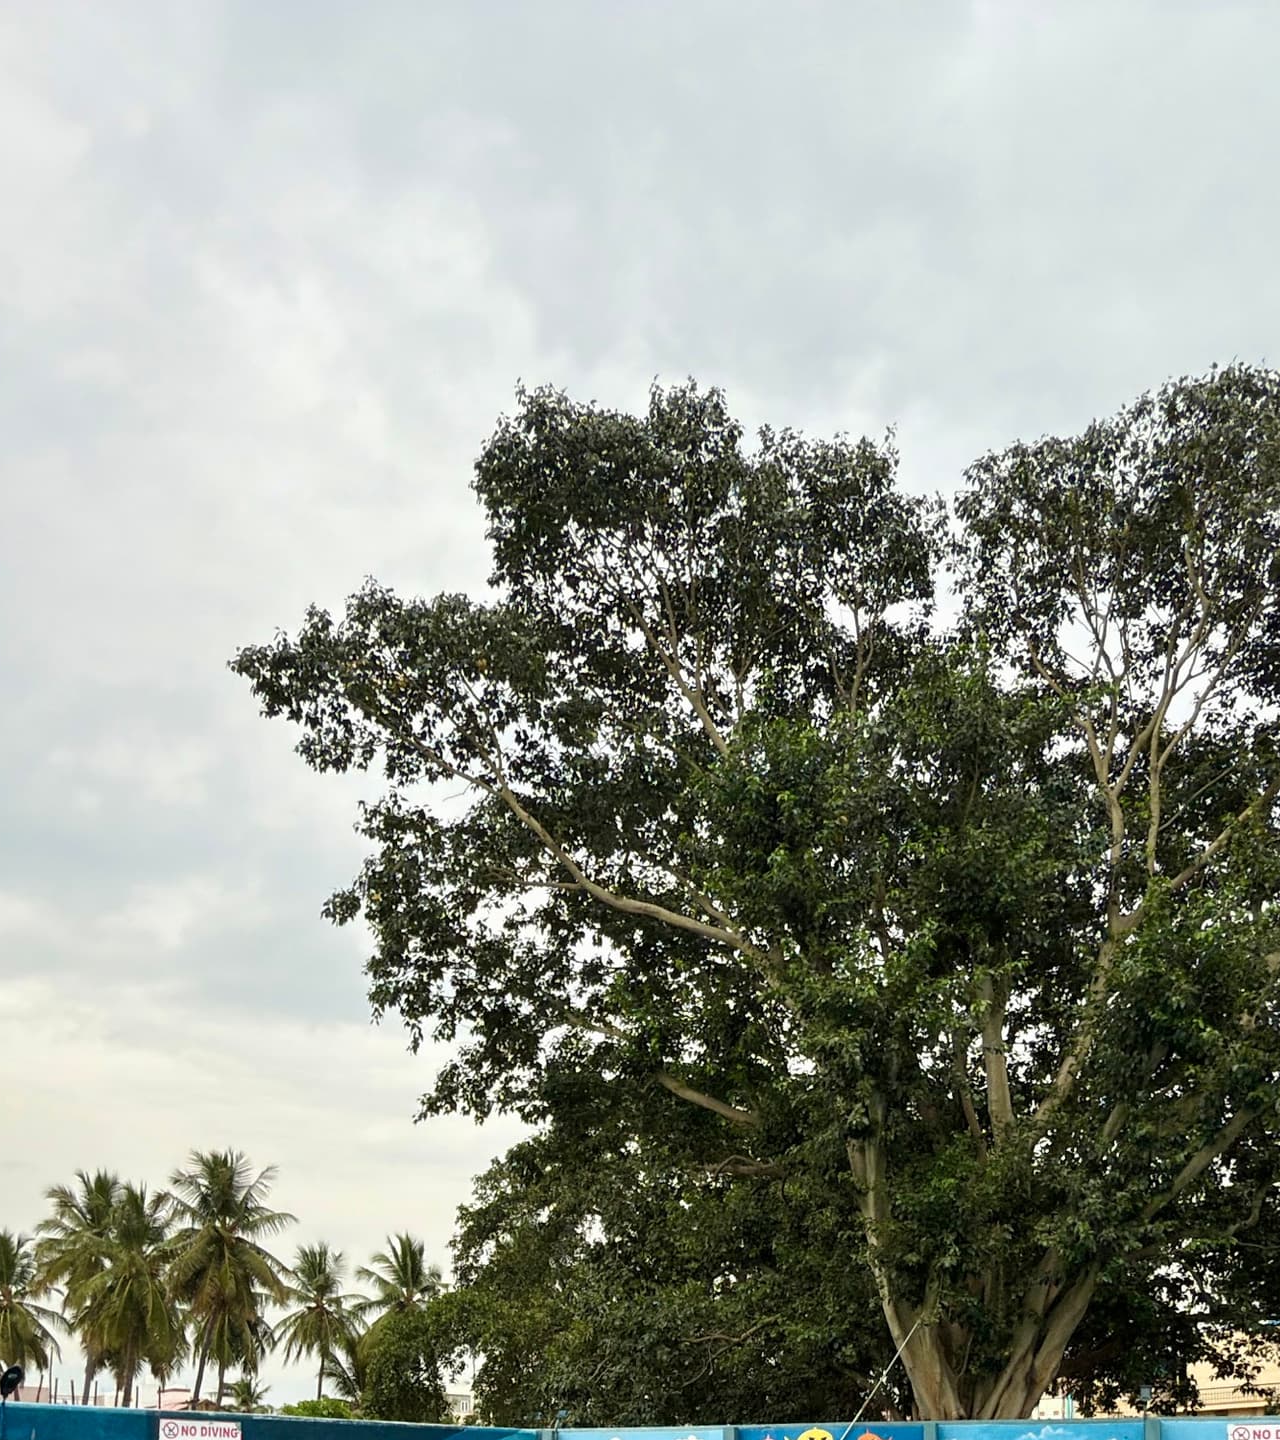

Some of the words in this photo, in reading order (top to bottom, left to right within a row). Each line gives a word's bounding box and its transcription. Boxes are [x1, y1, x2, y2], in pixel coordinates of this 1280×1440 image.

[181, 1425, 197, 1437] NO
[200, 1426, 238, 1438] DIVING
[1252, 1429, 1271, 1440] NO
